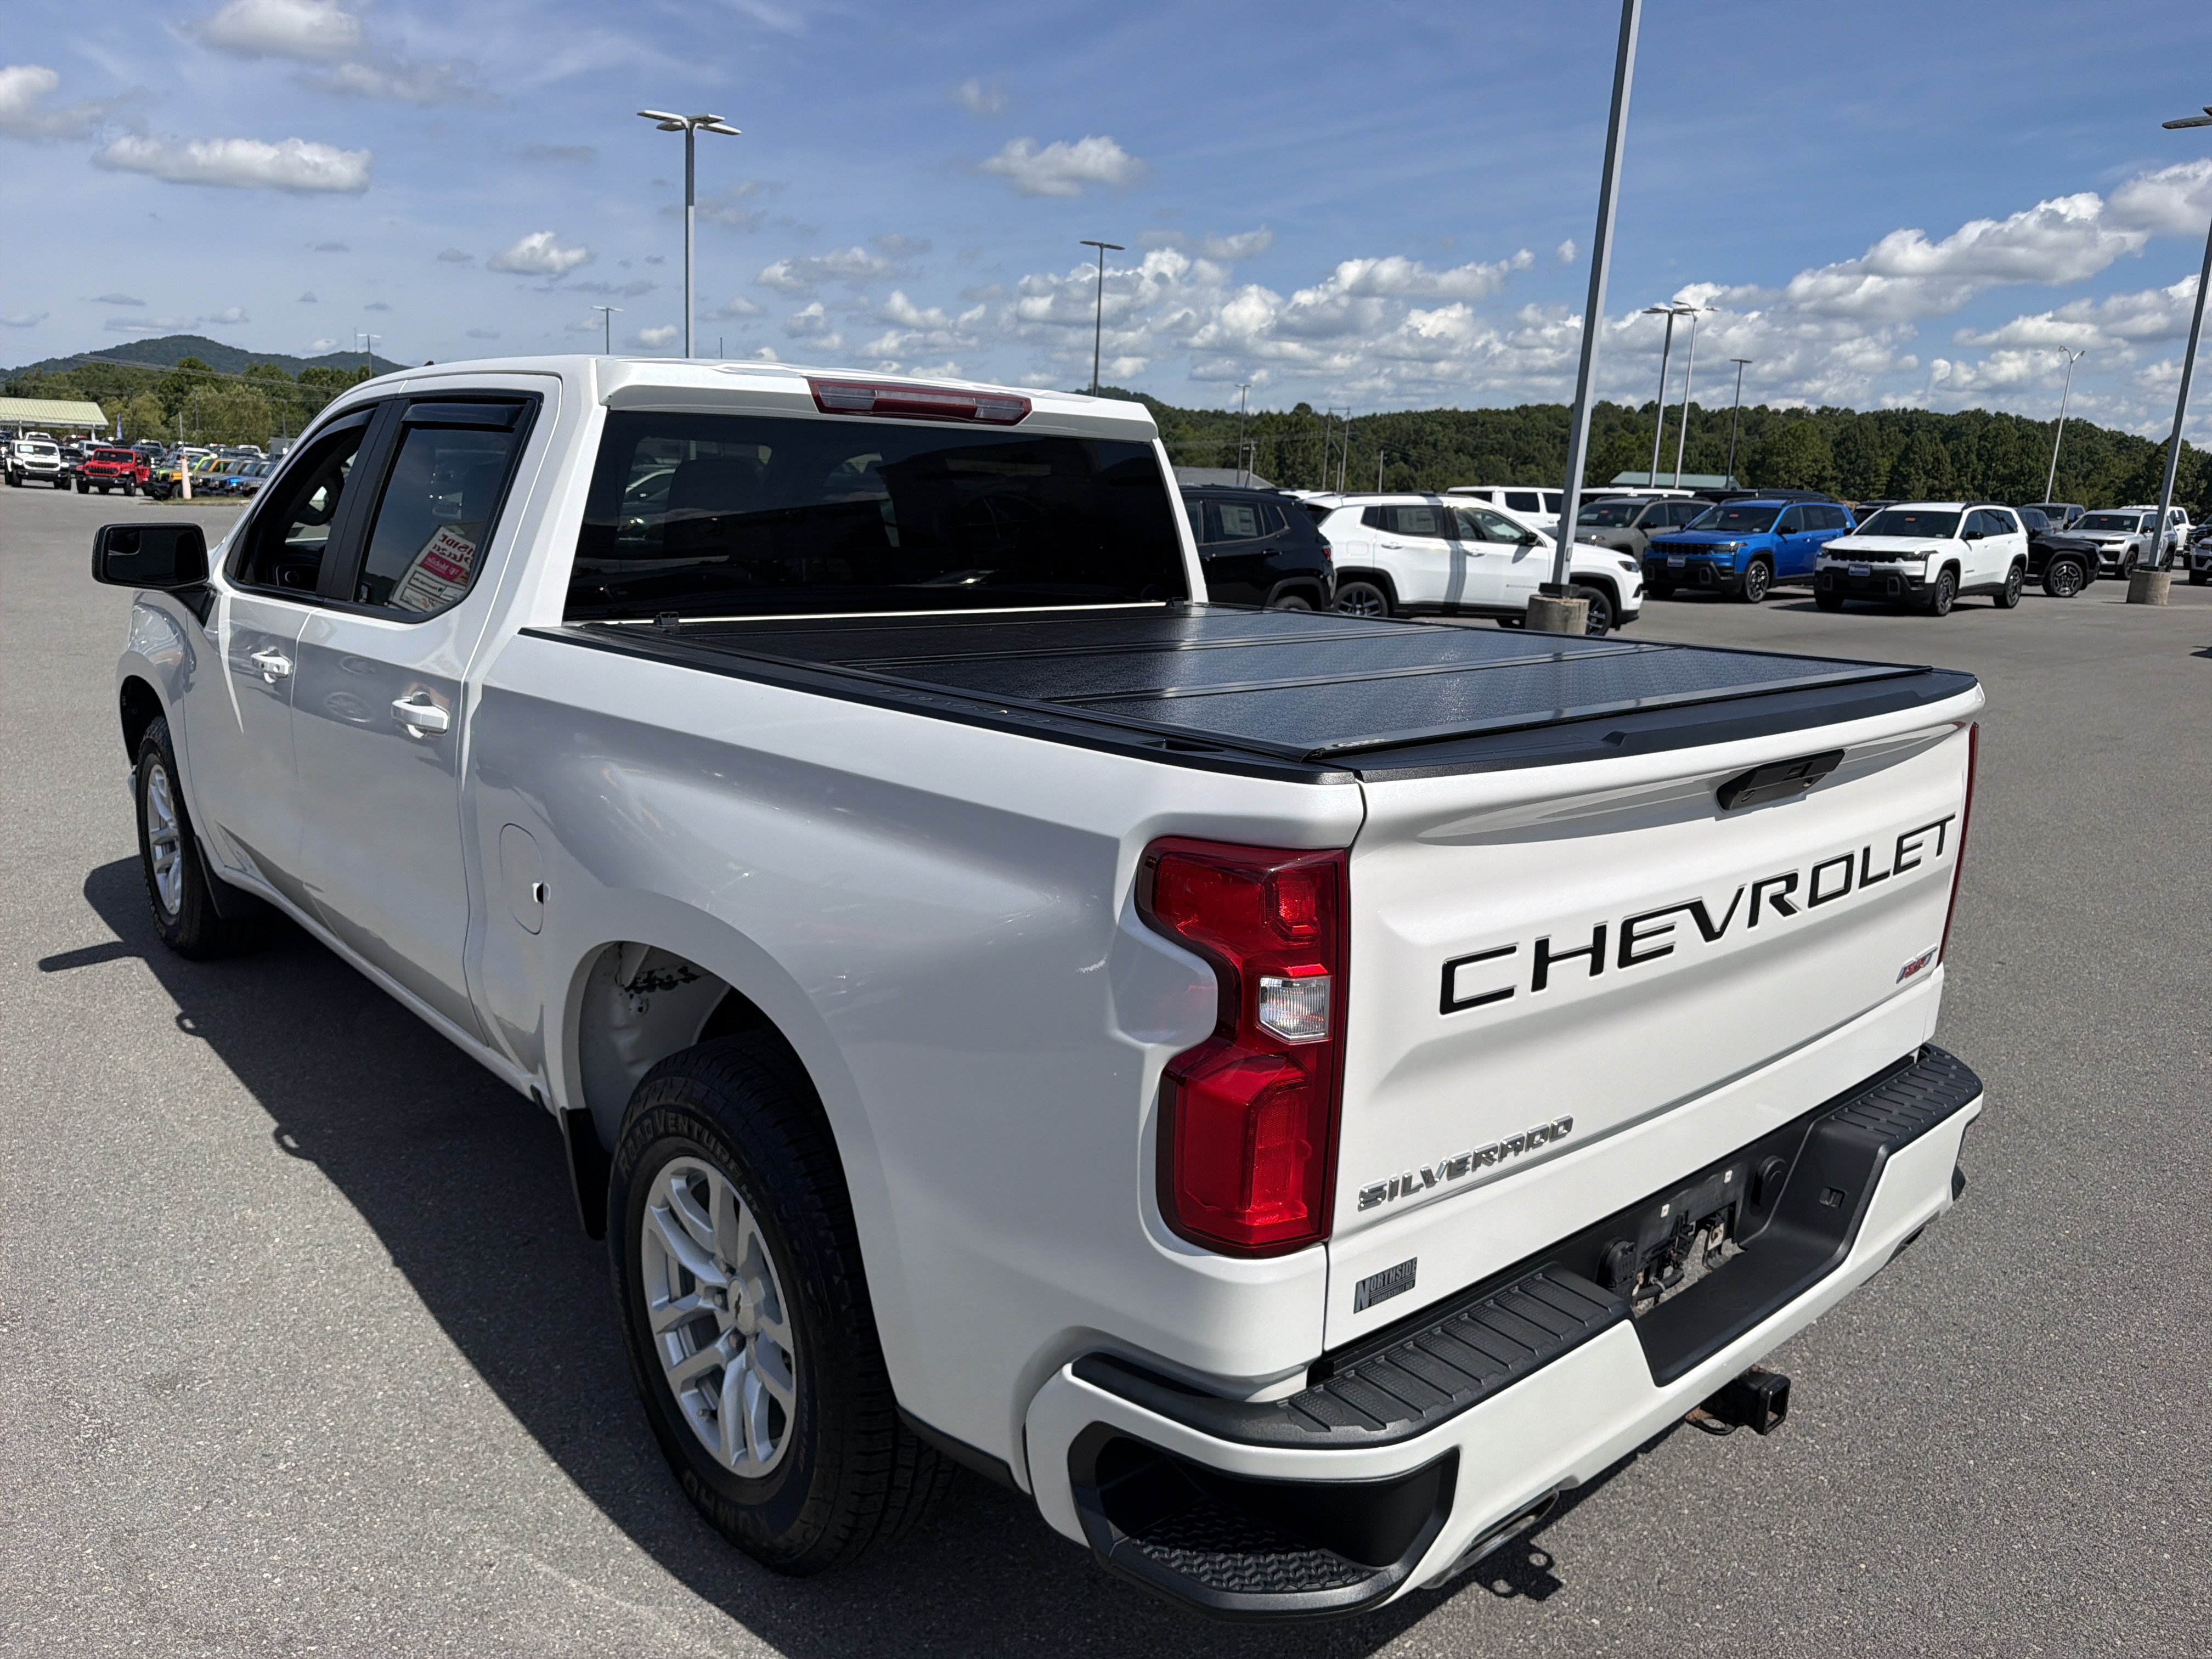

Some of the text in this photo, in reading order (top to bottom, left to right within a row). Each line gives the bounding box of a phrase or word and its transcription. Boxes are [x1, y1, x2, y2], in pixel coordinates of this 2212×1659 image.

[1438, 813, 1956, 1016] CHEVROLET
[1357, 1115, 1573, 1212] SILVERADO
[1355, 1259, 1417, 1312] NORTHSIDE
